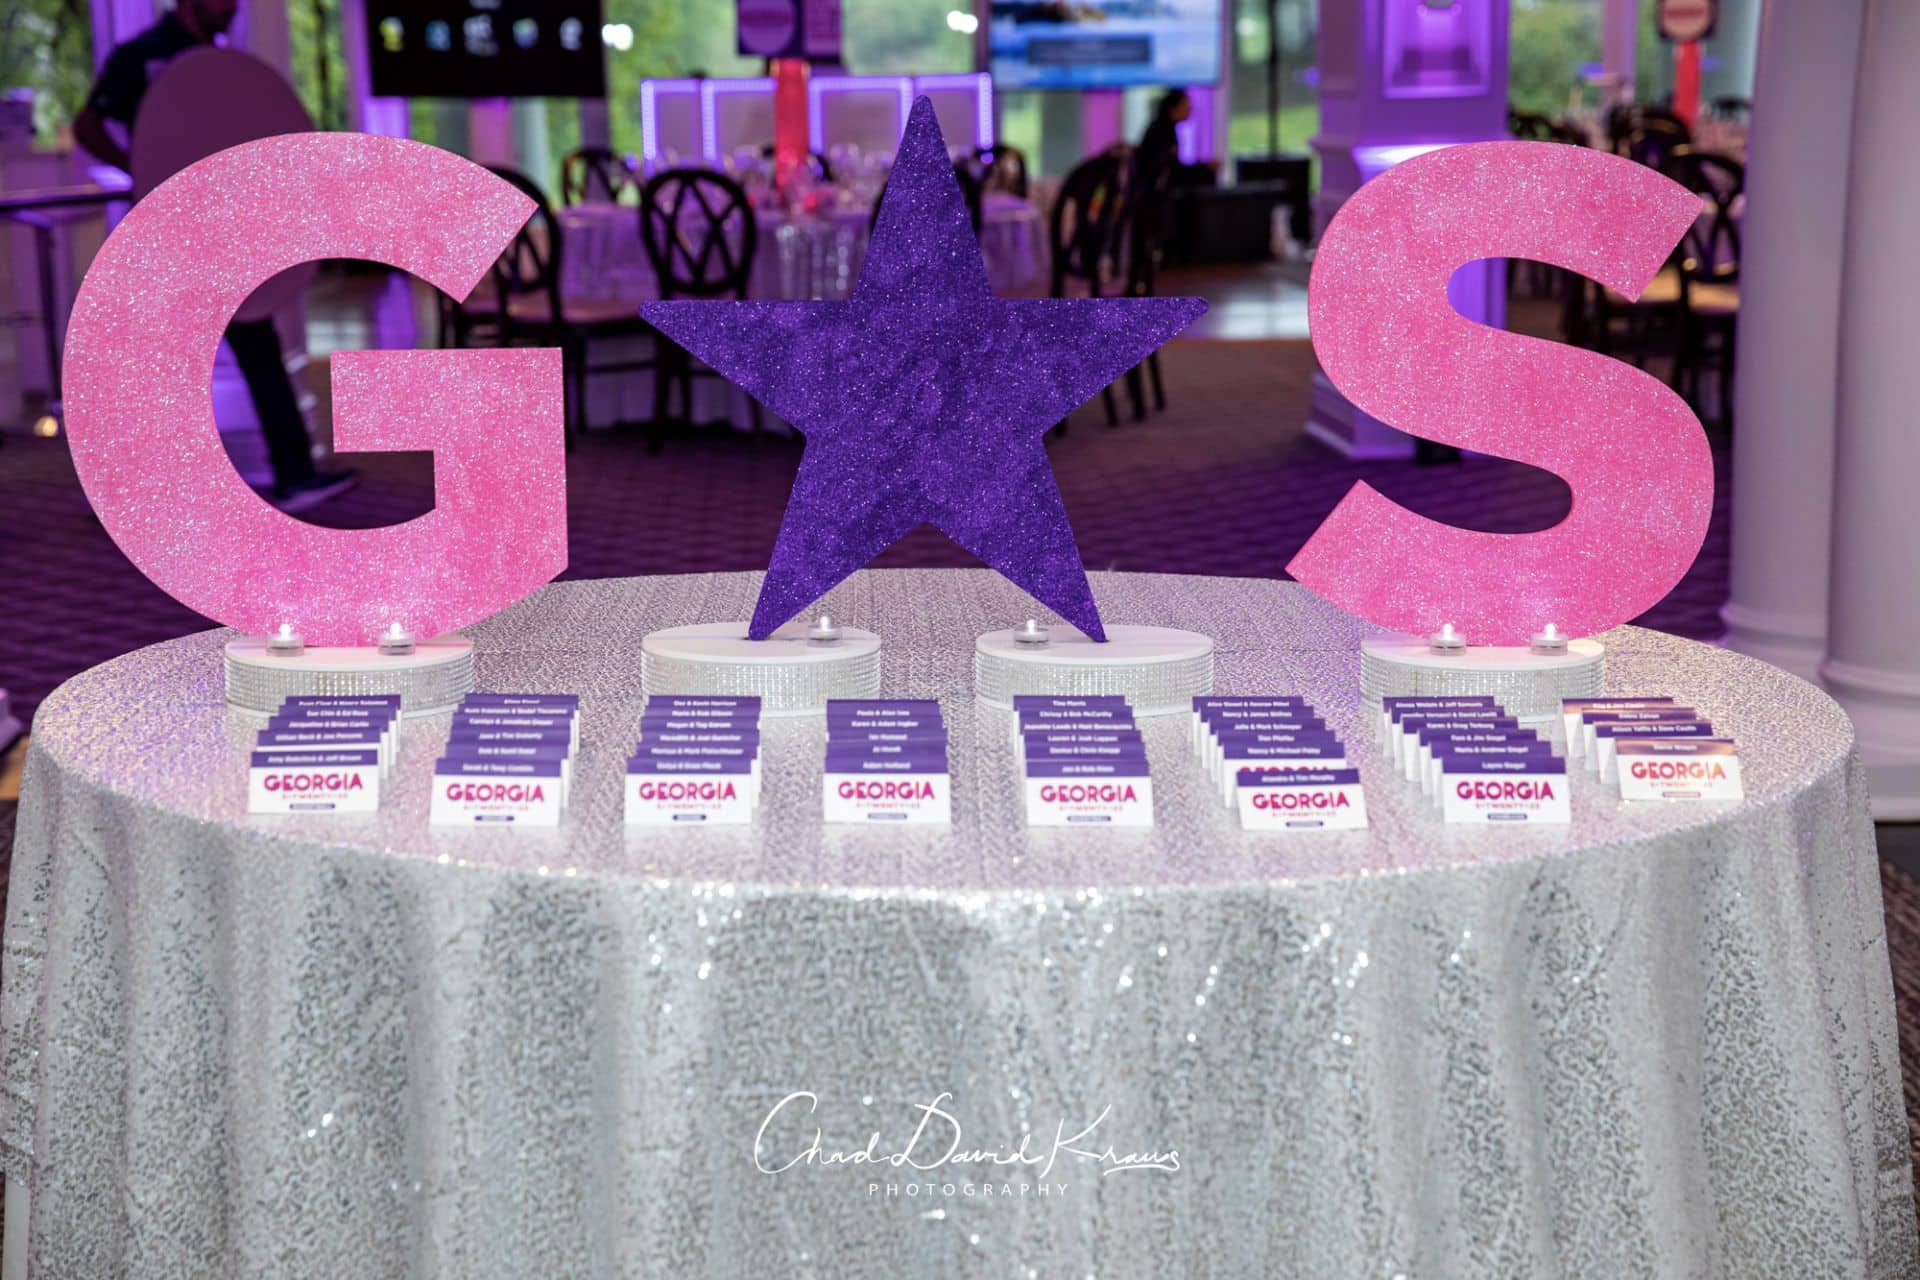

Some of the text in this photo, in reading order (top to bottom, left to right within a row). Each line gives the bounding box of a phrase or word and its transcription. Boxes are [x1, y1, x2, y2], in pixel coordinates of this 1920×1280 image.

[61, 131, 1714, 647] G S
[1631, 761, 1726, 779] GEORGIA
[264, 773, 362, 791] GEORGIA
[640, 782, 736, 800] GEORGIA
[839, 781, 935, 799] GEORGIA
[1457, 781, 1554, 800] GEORGIA
[447, 784, 544, 801] GEORGIA
[1041, 785, 1136, 802] GEORGIA
[1253, 792, 1349, 810] GEORGIA
